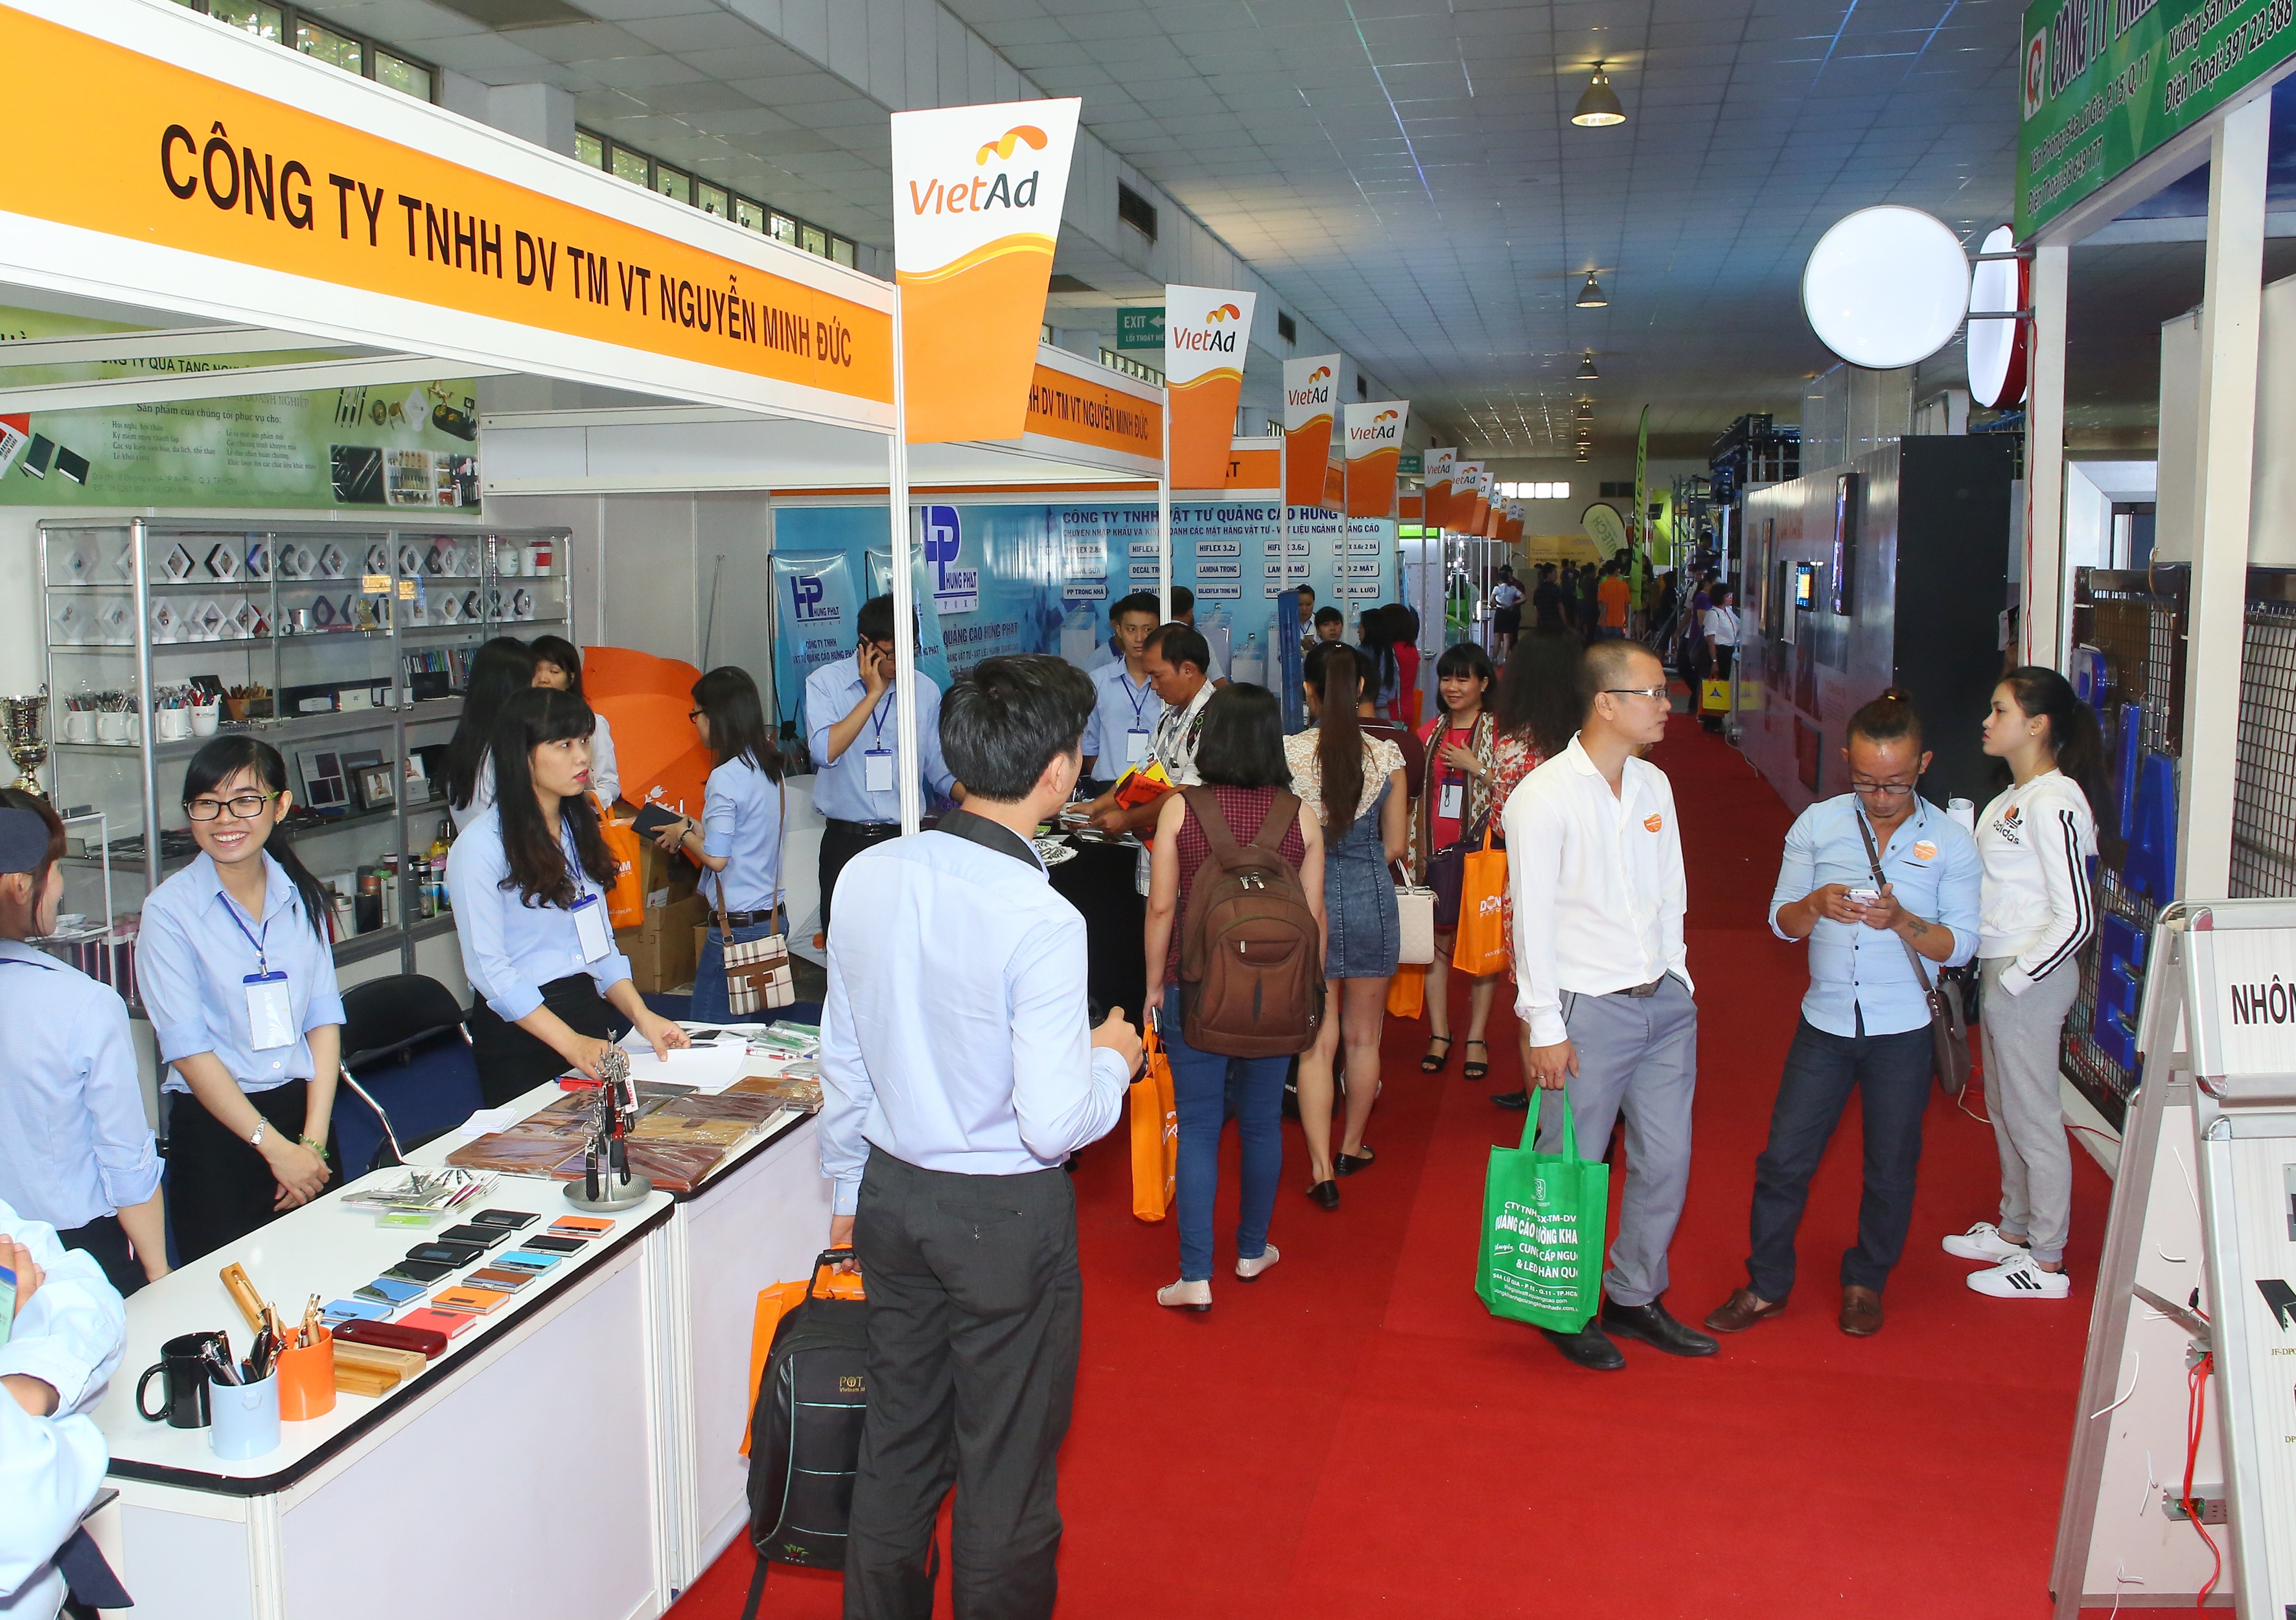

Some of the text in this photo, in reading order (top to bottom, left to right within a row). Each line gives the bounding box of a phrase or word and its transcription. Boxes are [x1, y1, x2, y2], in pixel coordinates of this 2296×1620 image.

[2167, 12, 2202, 64] Xưởng
[2164, 0, 2293, 115] Điện Thoại: 397 22 388
[2140, 50, 2150, 86] 11
[2062, 157, 2073, 190] 38
[2073, 146, 2087, 181] 649
[2088, 135, 2104, 171] 177
[910, 170, 1038, 216] VietAd
[161, 121, 852, 367] CÔNG TY TNHH DV TM VT NGUYỄN MINH ĐỨC
[1124, 316, 1146, 329] EXIT
[1137, 333, 1154, 342] THOÁT
[1174, 326, 1236, 353] VietAd
[1288, 386, 1328, 406] VietAd
[266, 415, 281, 423] cho:
[1042, 387, 1148, 441] DV TM VT NGUYỄN MINH ĐỨC
[1350, 425, 1395, 441] VietAd
[1427, 464, 1451, 474] VietAd
[1452, 476, 1476, 485] ietAd
[1063, 504, 1263, 524] CÔNG TY TNHH ẬT TƯ QUẢNG
[1134, 526, 1142, 536] VÀ
[1189, 525, 1204, 535] CÁC
[1205, 526, 1221, 537] MẶT
[1223, 524, 1243, 535] HÀNG
[1244, 524, 1258, 535] VẬT
[1260, 525, 1271, 534] TƯ
[1293, 524, 1310, 535] LIỆU
[1312, 524, 1336, 533] NGÀNH
[1364, 522, 1380, 533] CÁO
[1294, 564, 1305, 573] MỜ
[1359, 564, 1374, 573] MẶT
[817, 639, 824, 649] TY
[824, 638, 837, 648] TNHH
[943, 624, 967, 646] QUẢNG
[969, 623, 982, 642] CÁO
[820, 650, 829, 662] CÁO
[1993, 820, 2020, 844] adidas
[1504, 1201, 1520, 1211] CTY
[1518, 1217, 1535, 1238] CÁO
[1539, 1248, 1556, 1262] CẤP
[1516, 1258, 1523, 1269] &
[1524, 1260, 1538, 1274] LED
[1538, 1265, 1559, 1279] HÀN
